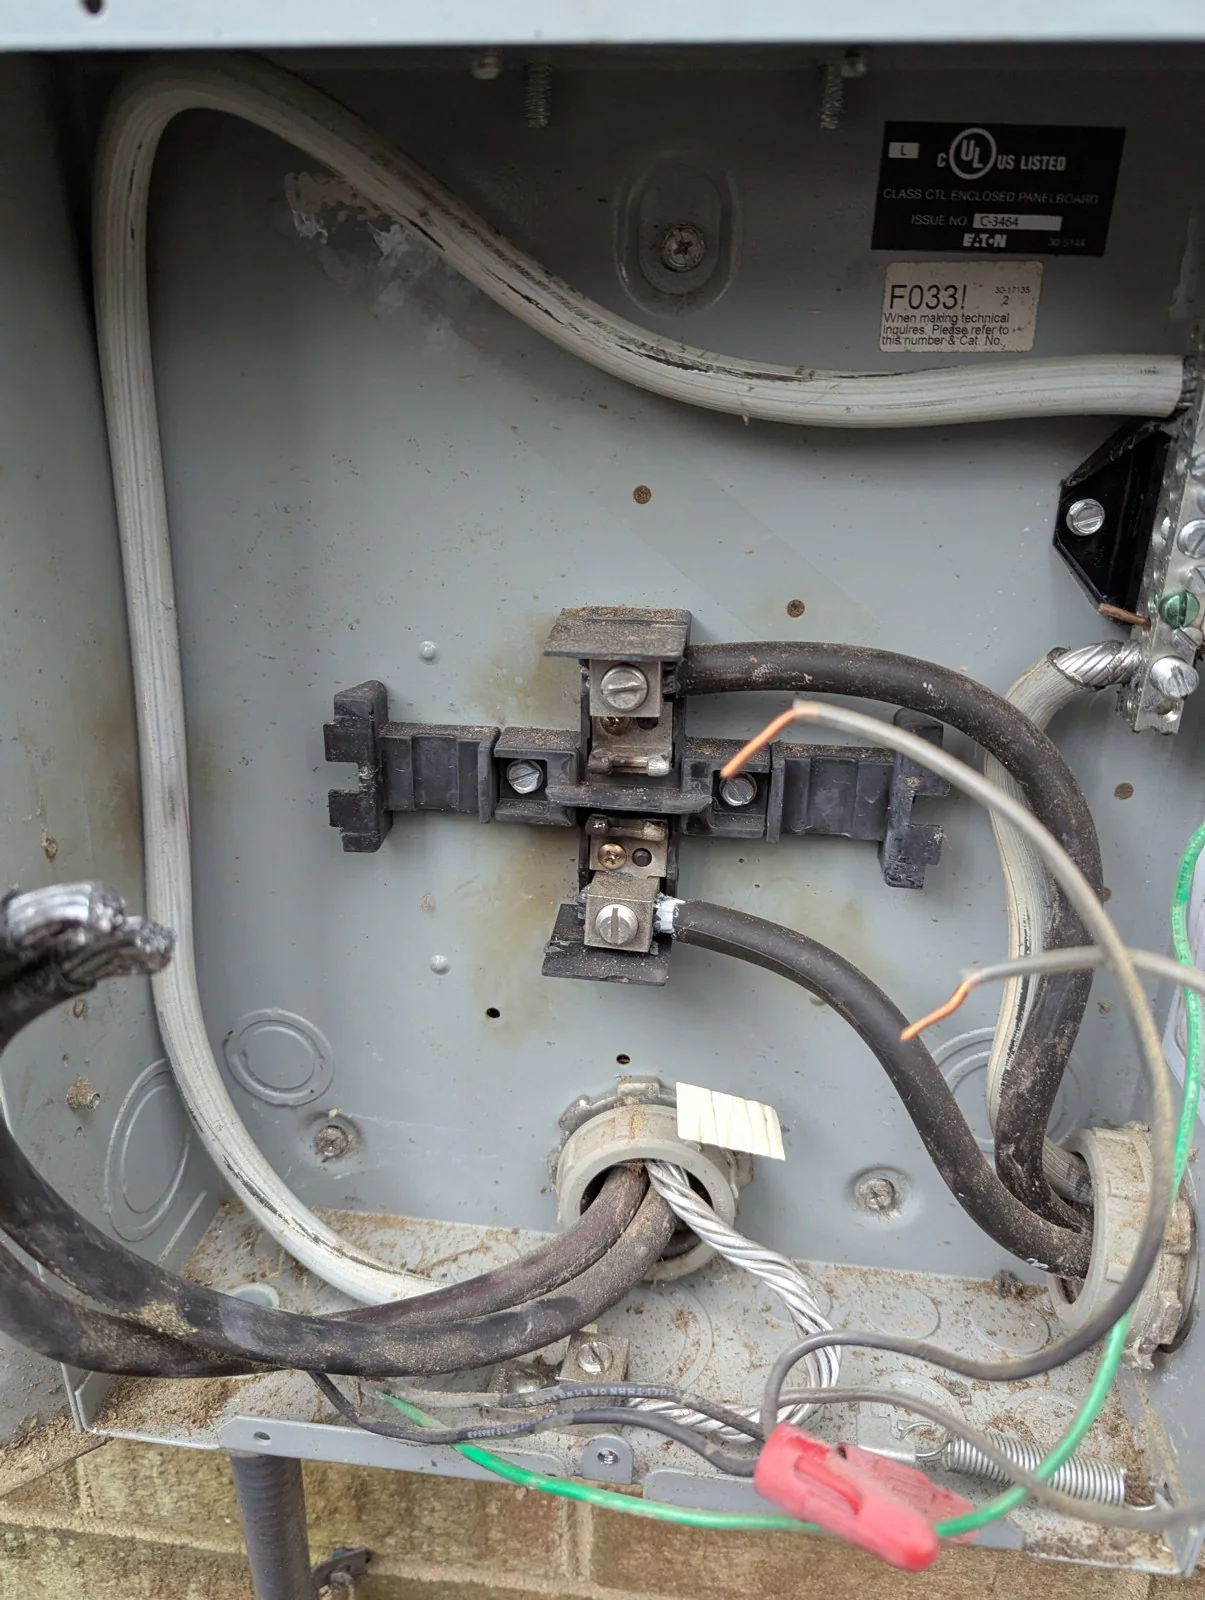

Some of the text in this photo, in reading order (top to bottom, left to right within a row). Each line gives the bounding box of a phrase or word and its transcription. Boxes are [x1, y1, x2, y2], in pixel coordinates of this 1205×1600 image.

[900, 145, 908, 156] L
[960, 139, 984, 169] UL
[997, 154, 1015, 170] US
[1020, 155, 1067, 171] LISTED
[883, 188, 1099, 205] CLASS CTL ENCLOSED PANELBOARD
[911, 214, 945, 225] ISSUE
[980, 215, 1019, 228] C-3464
[883, 312, 1010, 326] When making technical
[932, 324, 968, 336] Please
[971, 324, 996, 336] refer
[999, 325, 1009, 336] to
[882, 336, 901, 346] this
[904, 335, 945, 346] number
[948, 335, 956, 346] &
